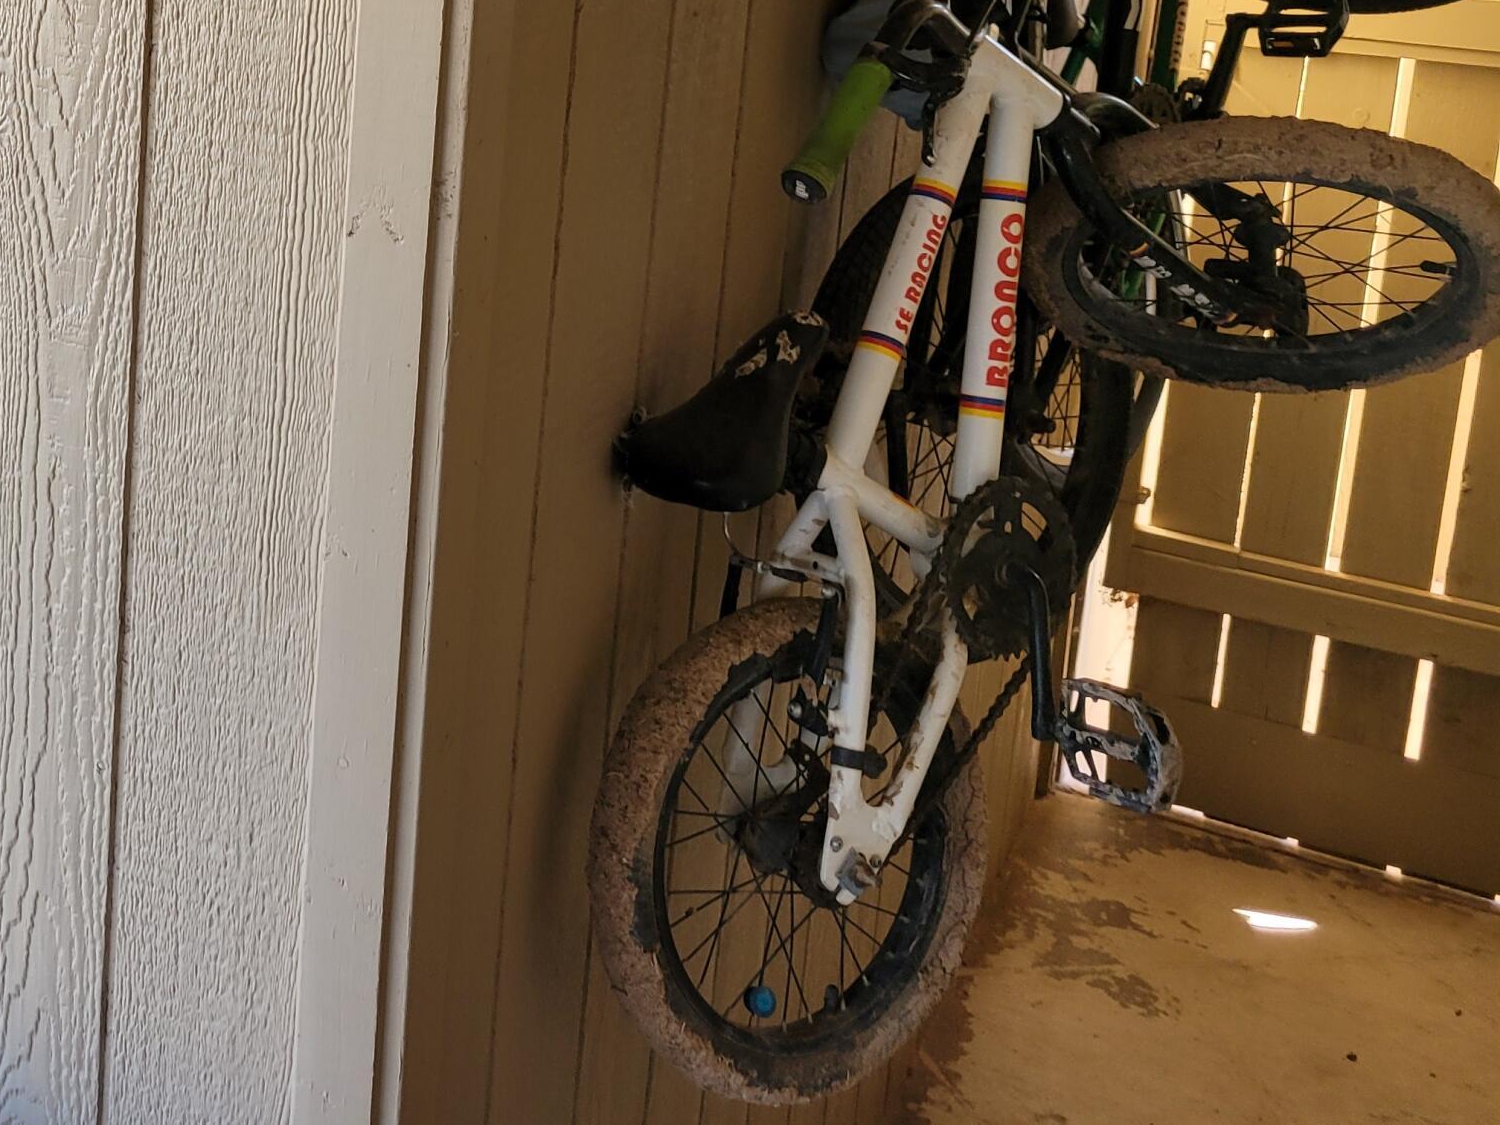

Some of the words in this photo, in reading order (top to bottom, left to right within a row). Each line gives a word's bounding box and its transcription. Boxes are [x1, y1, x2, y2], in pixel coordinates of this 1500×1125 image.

[894, 306, 914, 335] SE
[904, 213, 948, 305] RACING
[985, 212, 1025, 388] BRONCO
